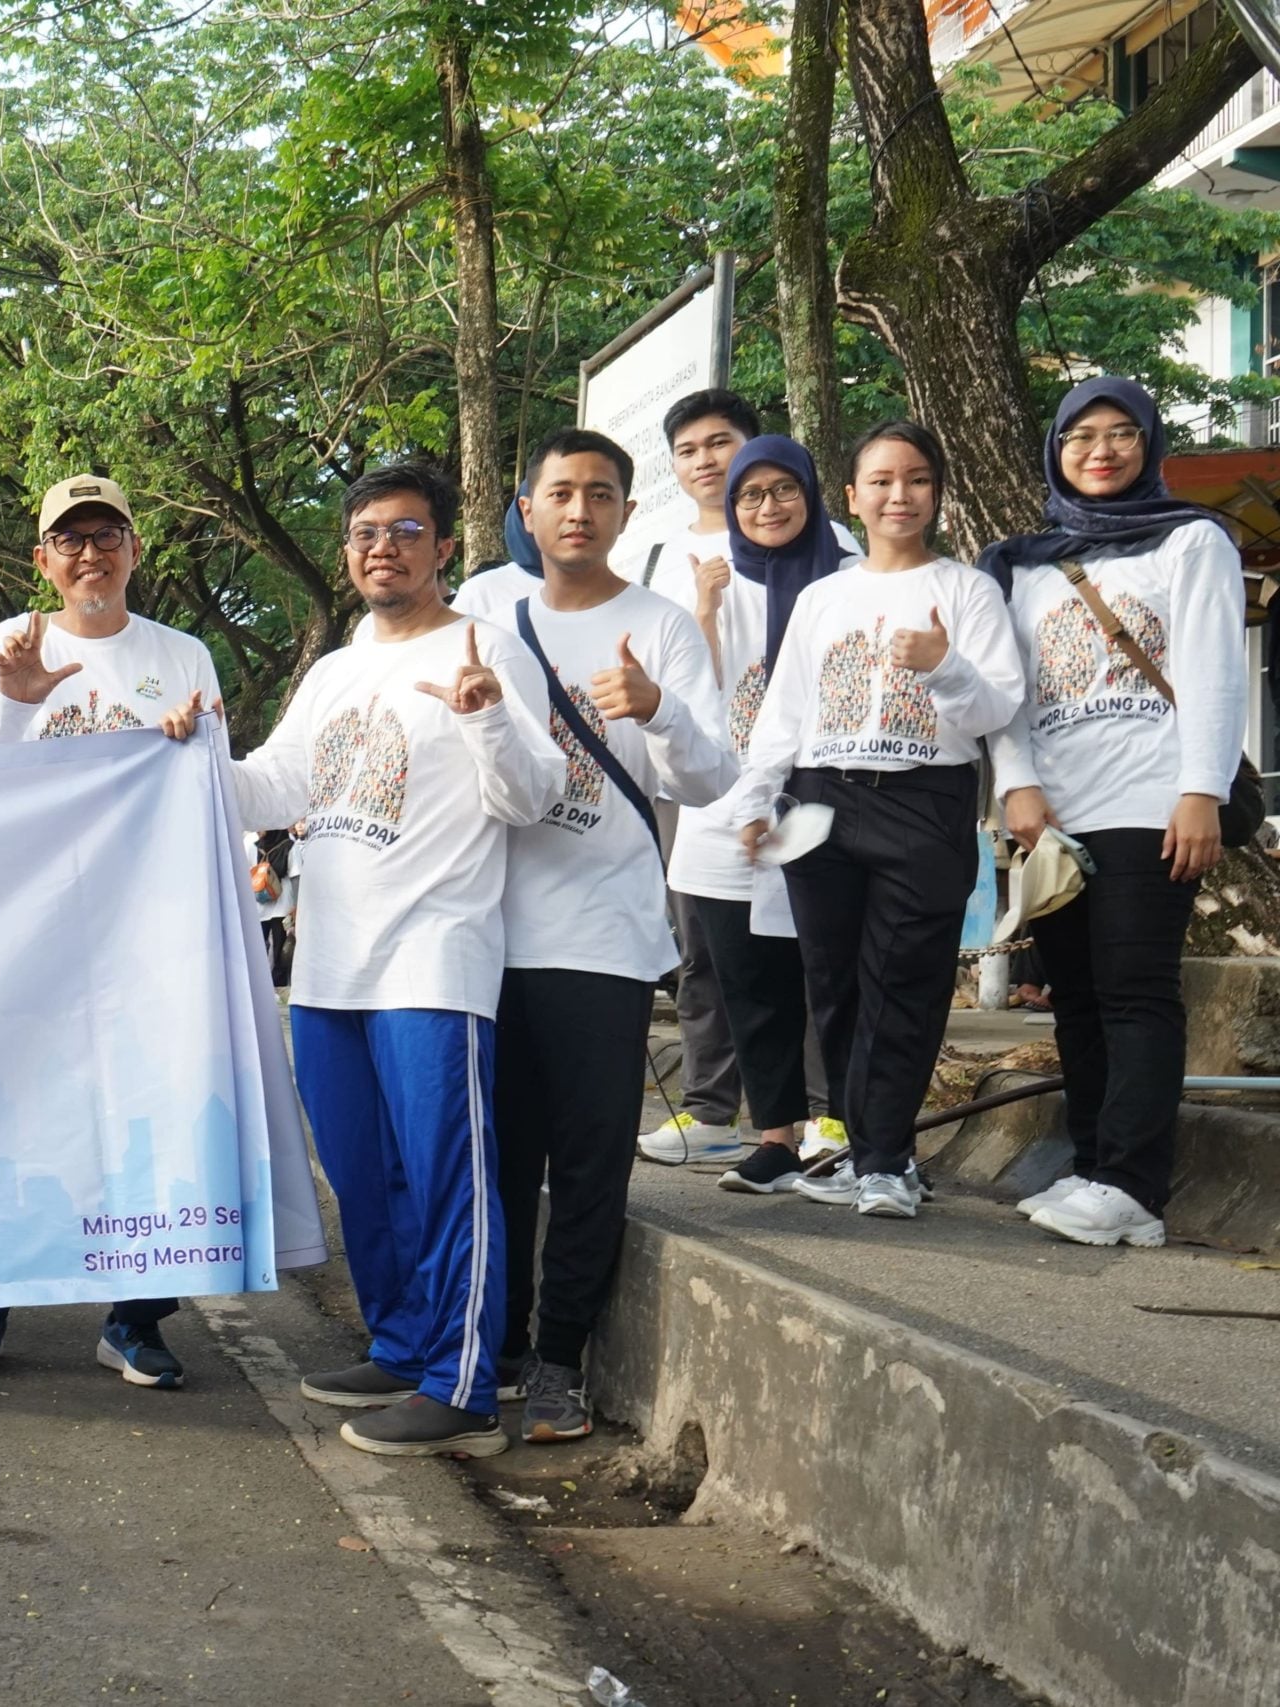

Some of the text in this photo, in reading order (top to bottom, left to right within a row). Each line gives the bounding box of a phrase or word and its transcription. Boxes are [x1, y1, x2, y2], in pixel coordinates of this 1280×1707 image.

[1039, 706, 1080, 729] WORLD
[1085, 697, 1134, 715] LUNG
[1140, 699, 1171, 716] DAY
[812, 738, 940, 760] WORLD LUNG DAY
[326, 815, 363, 833] LUNG
[366, 823, 401, 846] DAY
[566, 807, 602, 829] DAY
[82, 1213, 173, 1238] Minggu,
[179, 1206, 208, 1227] 29
[84, 1244, 243, 1274] Siring Menara
